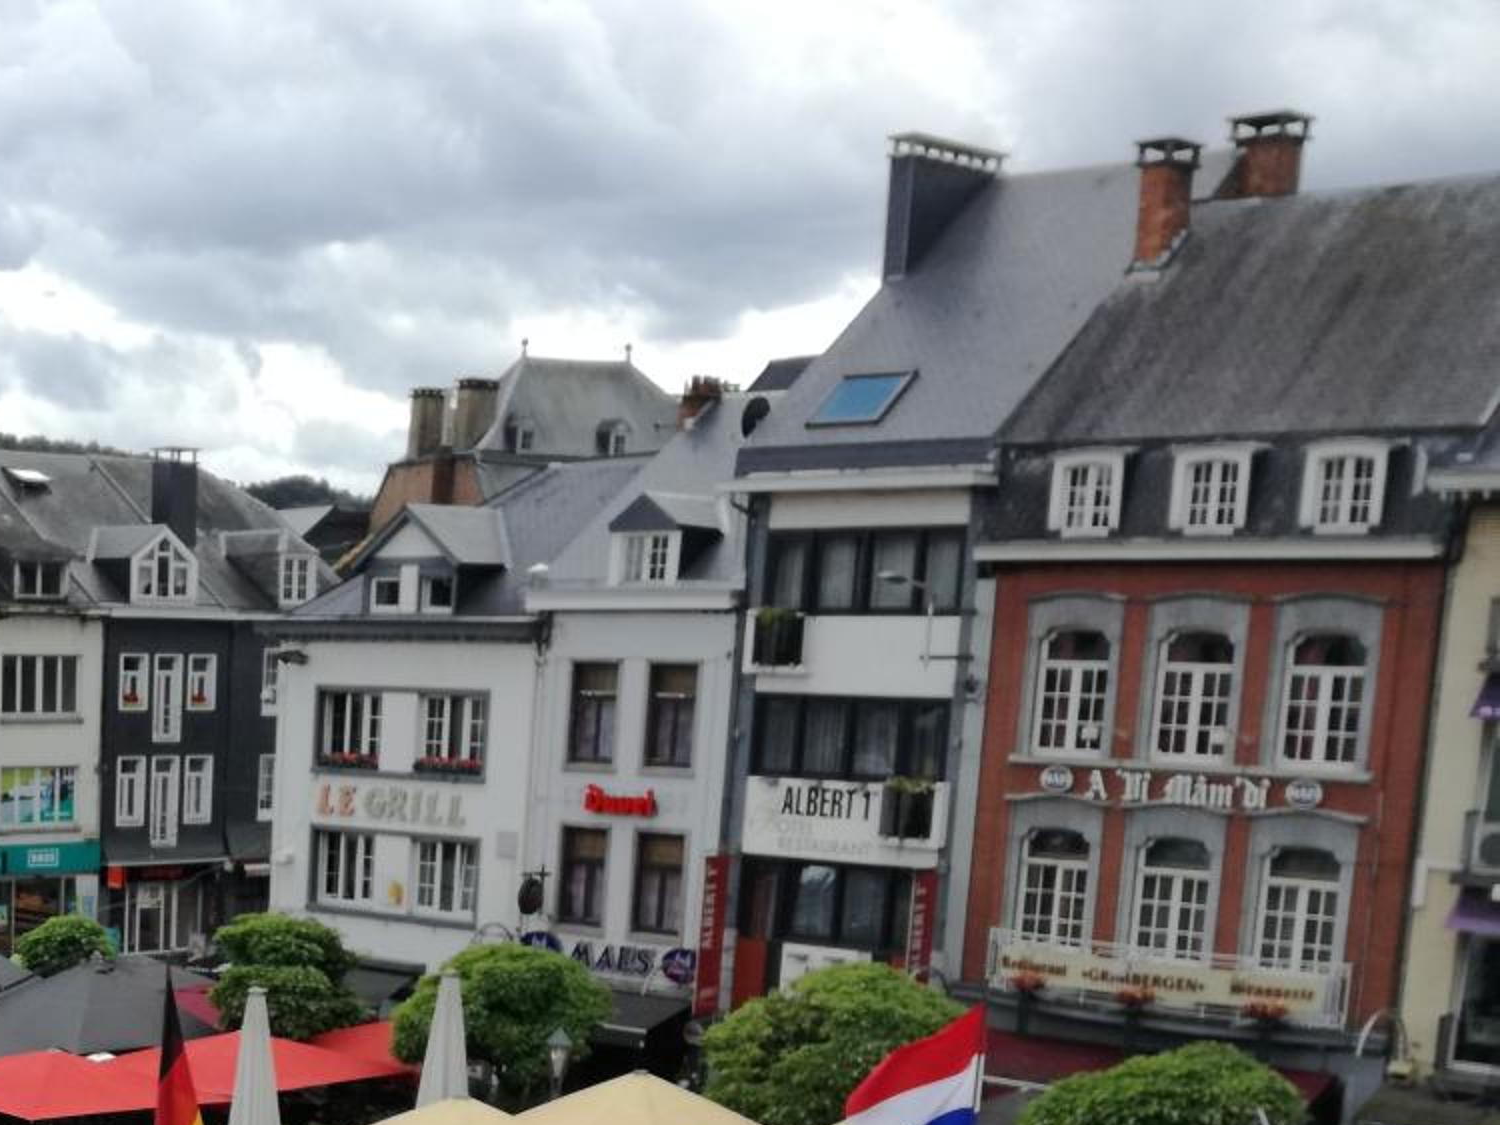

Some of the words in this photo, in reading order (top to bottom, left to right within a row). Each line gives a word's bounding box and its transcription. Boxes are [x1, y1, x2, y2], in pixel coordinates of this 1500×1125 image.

[1083, 769, 1108, 801] A
[317, 783, 357, 817] LE
[364, 786, 466, 827] GRILL
[781, 786, 858, 820] ALBERT
[700, 880, 718, 950] ALBERT
[572, 943, 653, 974] MAES
